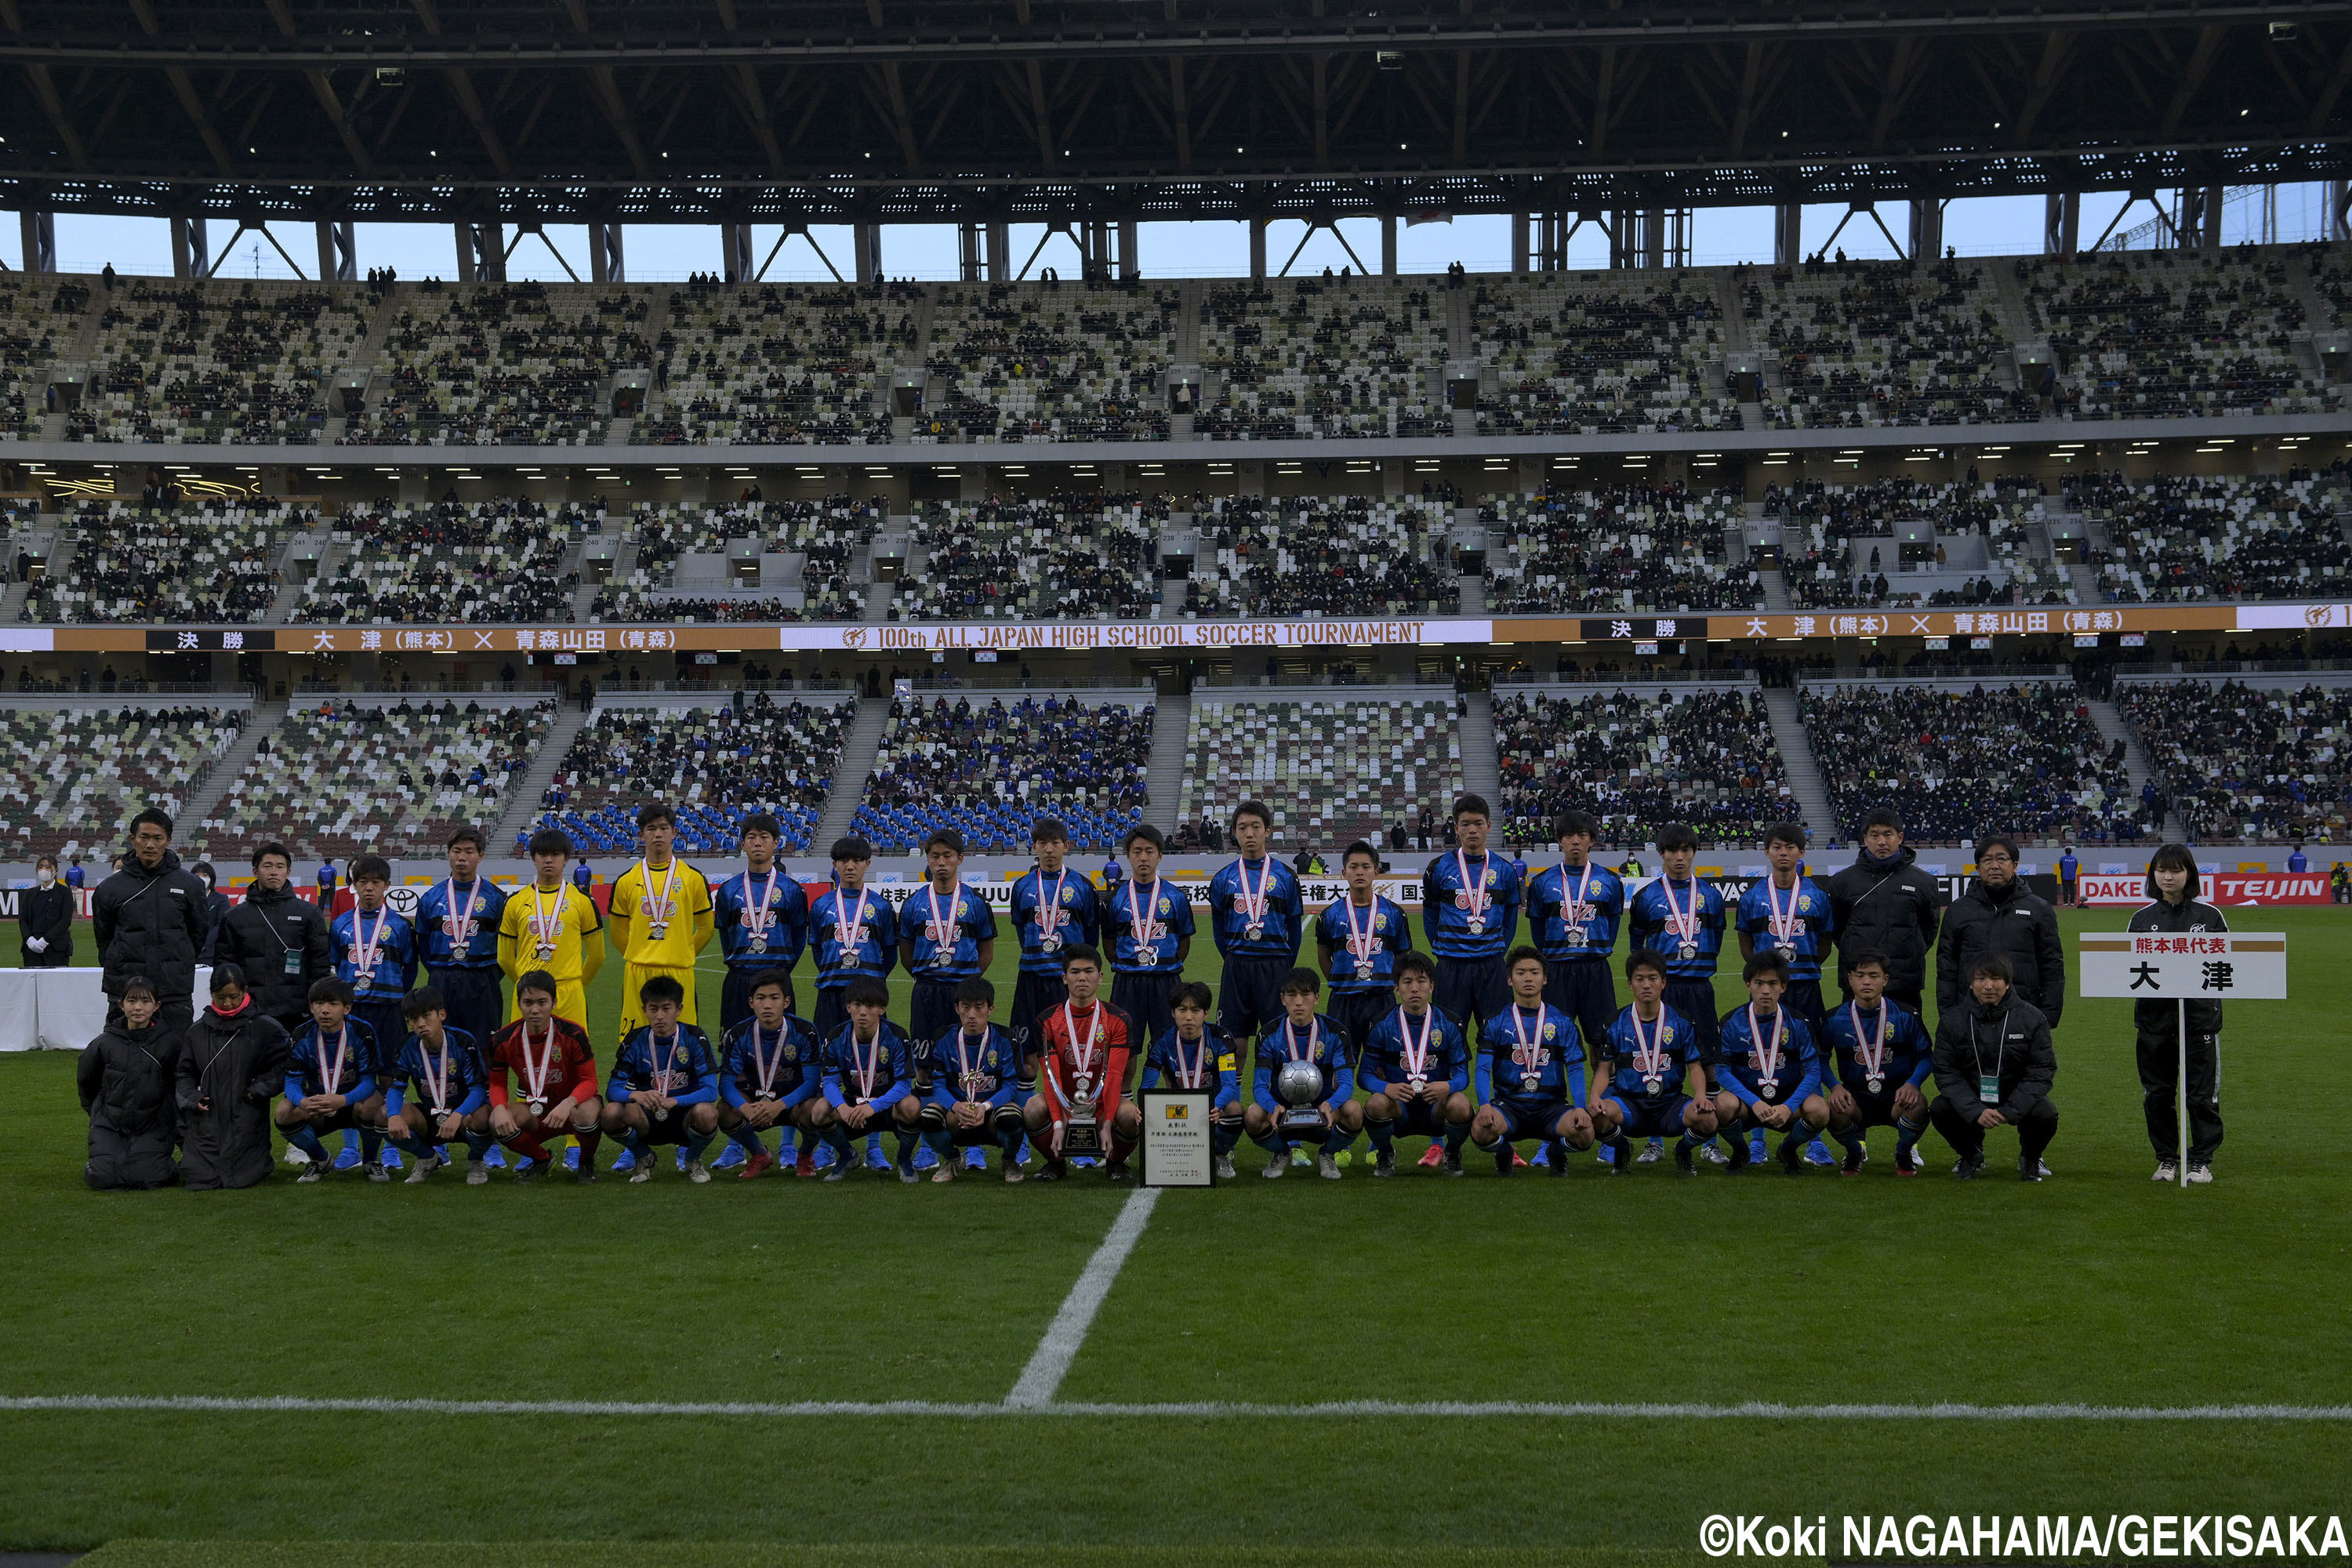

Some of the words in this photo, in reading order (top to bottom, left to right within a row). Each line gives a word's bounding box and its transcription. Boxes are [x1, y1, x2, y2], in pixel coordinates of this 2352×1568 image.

[879, 628, 926, 647] 100th
[935, 628, 971, 647] ALL
[978, 627, 1043, 646] JAPAN
[1052, 627, 1099, 646] HIGH
[1108, 626, 1189, 645] SCHOOL
[1196, 625, 1276, 644] SOCCER
[1284, 623, 1425, 644] TOURNAMENT
[2085, 881, 2141, 897] DAKE
[2220, 880, 2325, 899] TEIJIN
[2136, 938, 2226, 954] 熊本県代表
